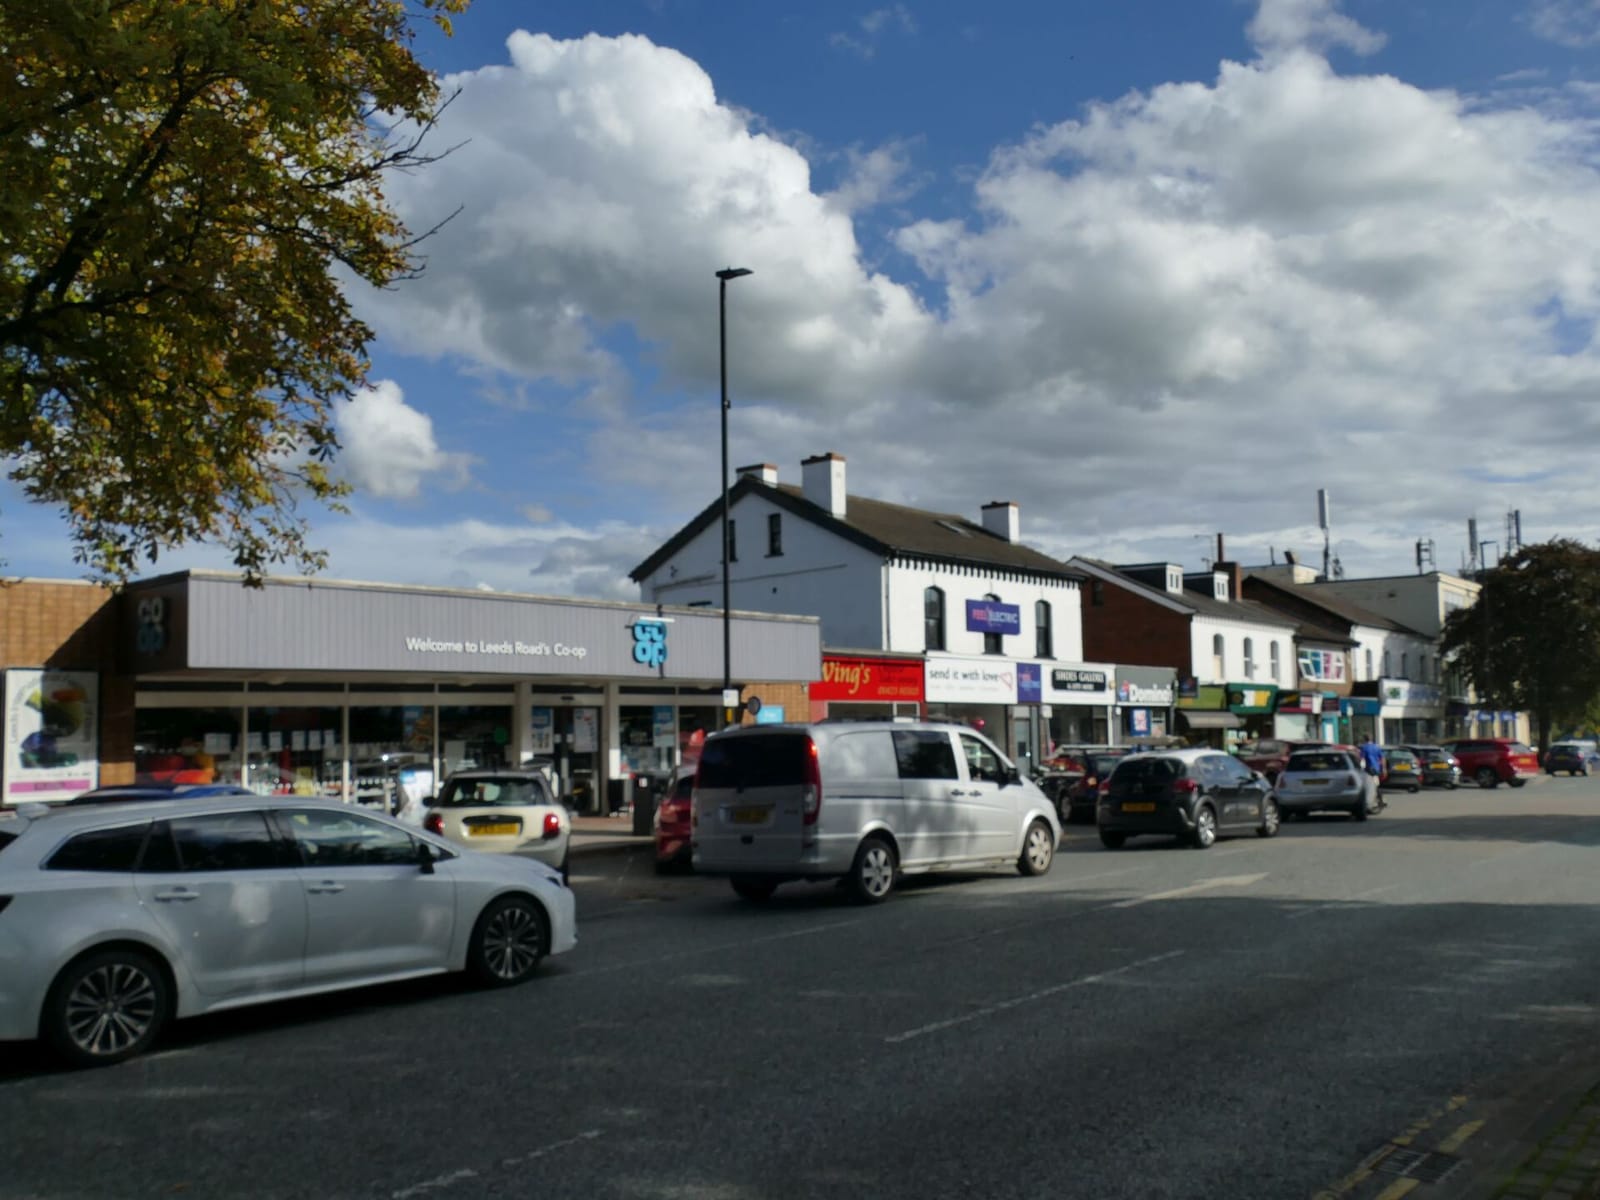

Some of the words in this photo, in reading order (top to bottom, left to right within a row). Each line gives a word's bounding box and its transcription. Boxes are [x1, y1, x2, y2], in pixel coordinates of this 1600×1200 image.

[406, 636, 462, 653] Welcome
[464, 641, 477, 653] to
[480, 640, 513, 655] Leeds
[515, 641, 550, 656] Road's
[554, 643, 587, 660] Co-op
[929, 667, 950, 680] send
[953, 669, 959, 680] it
[962, 669, 980, 681] with
[982, 670, 999, 682] love
